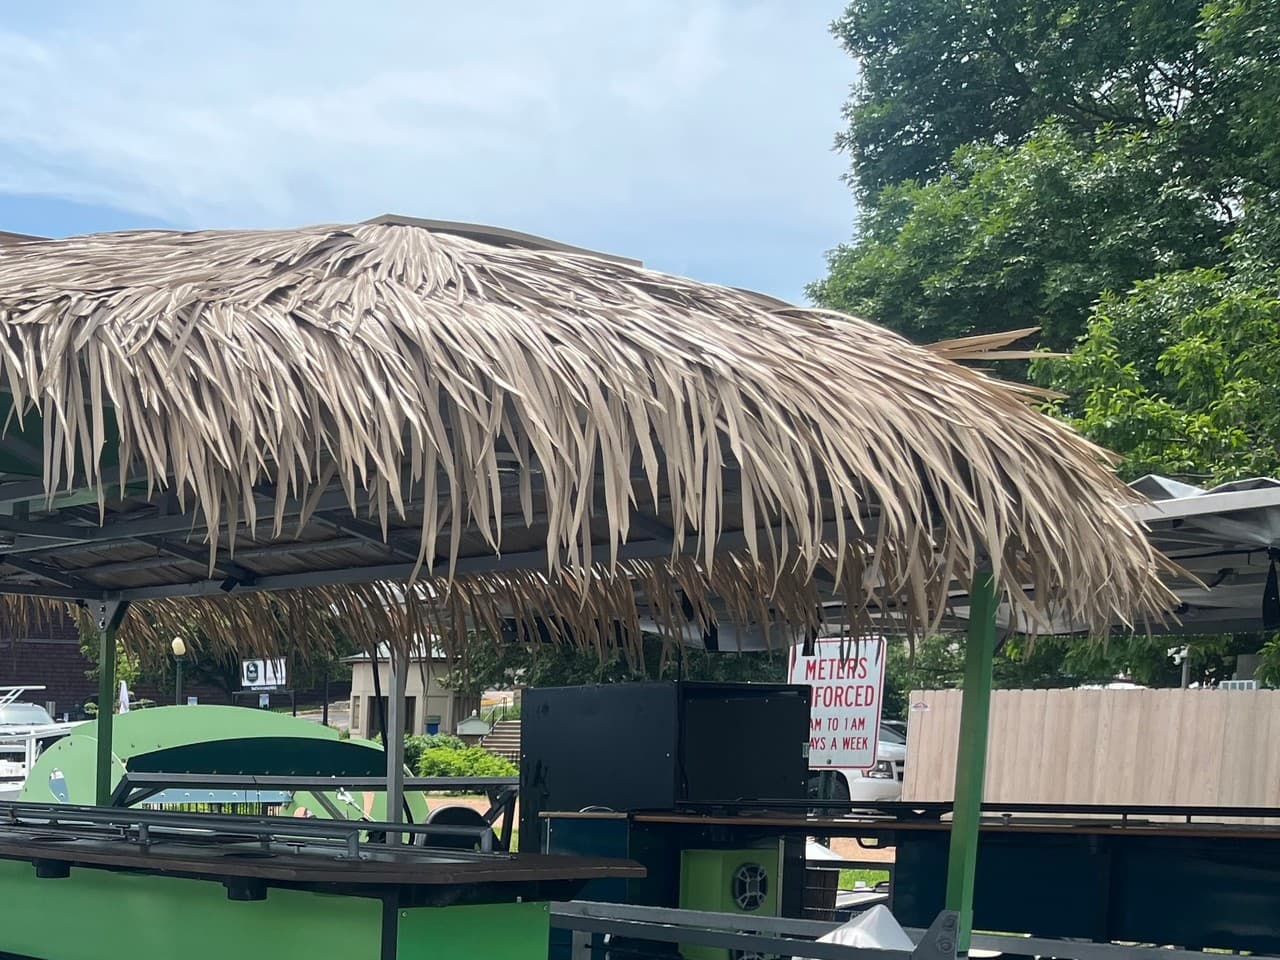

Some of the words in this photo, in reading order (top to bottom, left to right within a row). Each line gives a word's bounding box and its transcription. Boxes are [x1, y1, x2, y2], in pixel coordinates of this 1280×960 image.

[805, 657, 867, 680] METERS
[811, 685, 874, 707] FORCED
[828, 717, 839, 731] TO
[809, 736, 826, 750] AYS
[830, 736, 837, 750] A
[842, 736, 869, 750] WEEK
